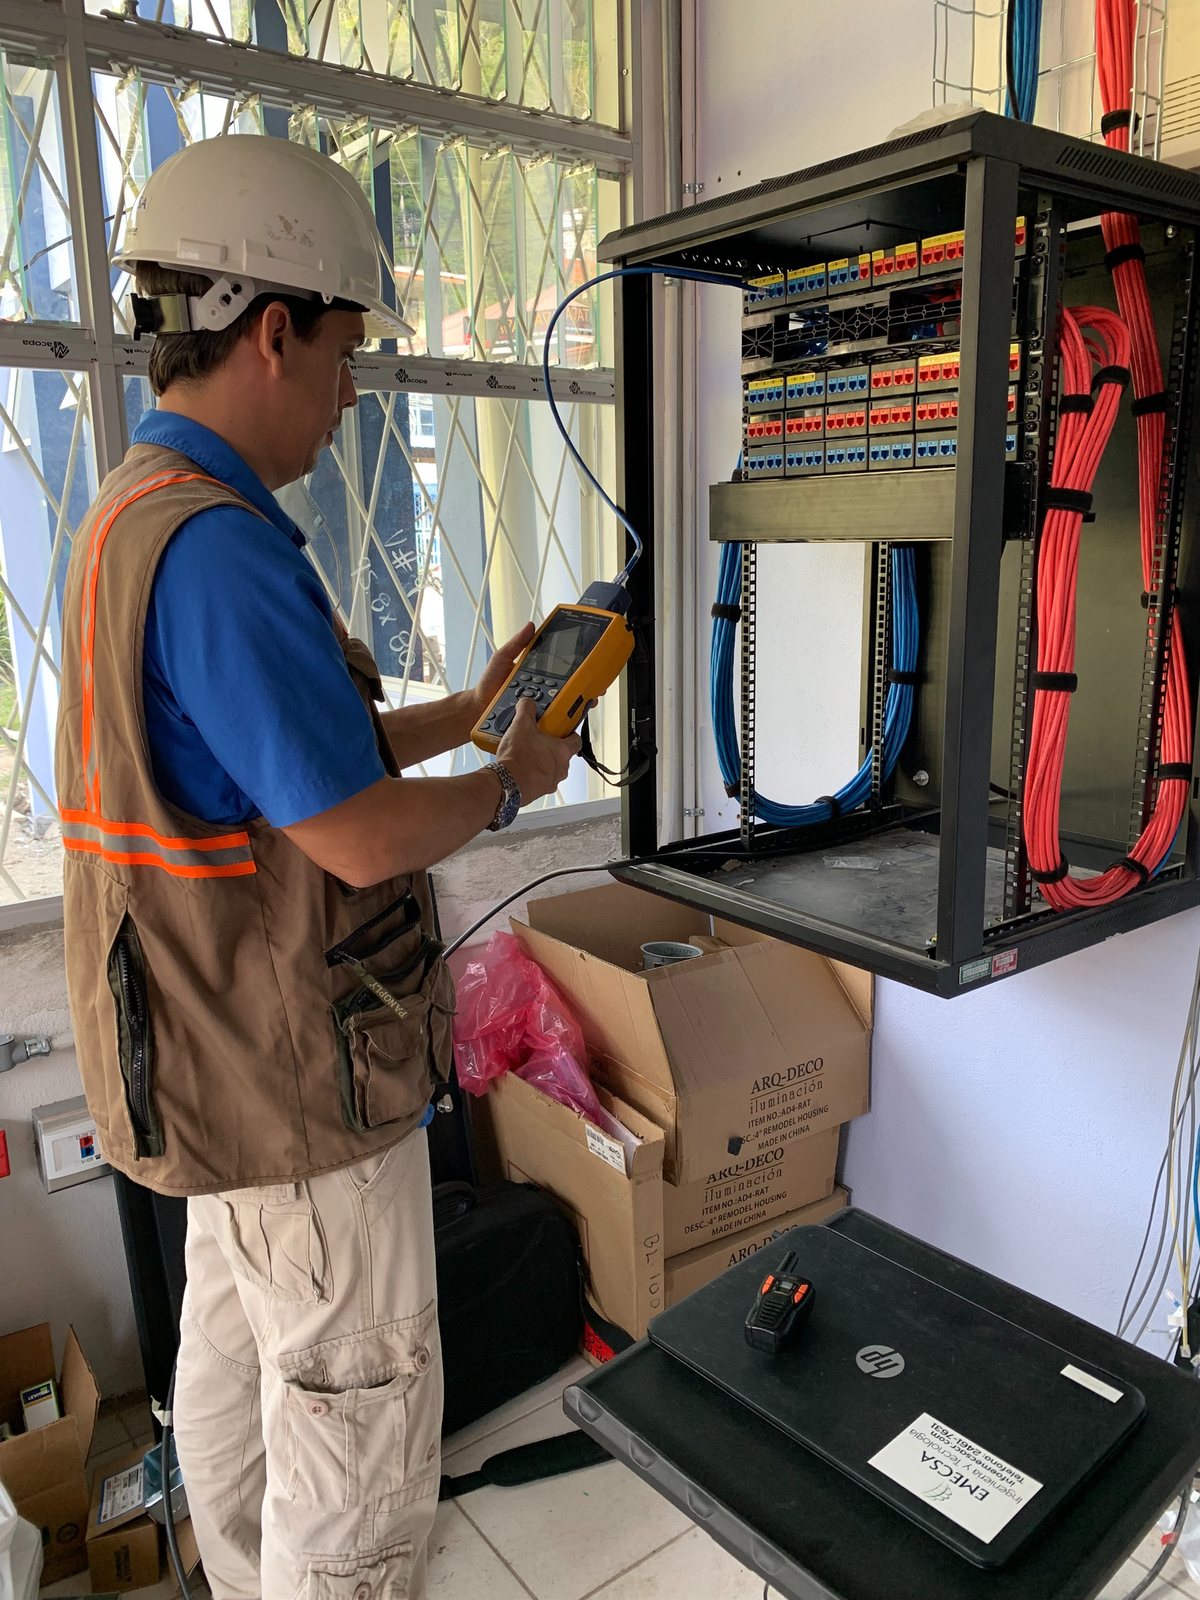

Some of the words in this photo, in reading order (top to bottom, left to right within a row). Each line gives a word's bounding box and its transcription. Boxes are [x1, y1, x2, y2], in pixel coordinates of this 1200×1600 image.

[369, 983, 407, 1018] PANOPLY
[751, 1057, 824, 1095] ARQ-DECO
[750, 1080, 823, 1114] iluminación
[748, 1117, 765, 1129] ITEM
[763, 1118, 797, 1135] REMODEL
[797, 1105, 829, 1121] HOUSING
[758, 1136, 779, 1151] MADE
[779, 1133, 787, 1142] IN
[788, 1125, 810, 1138] CHINA
[706, 1147, 784, 1185] ARQ-DECO
[705, 1168, 782, 1203] iluminación
[702, 1205, 721, 1216] ITEM
[718, 1205, 753, 1222] REMODEL
[754, 1191, 787, 1208] HOUSING
[711, 1223, 733, 1237] MADE
[734, 1218, 742, 1227] IN
[743, 1210, 767, 1224] CHINA
[857, 1346, 903, 1377] hp
[930, 1422, 982, 1456] 2461-7631
[921, 1451, 990, 1501] EMECSA
